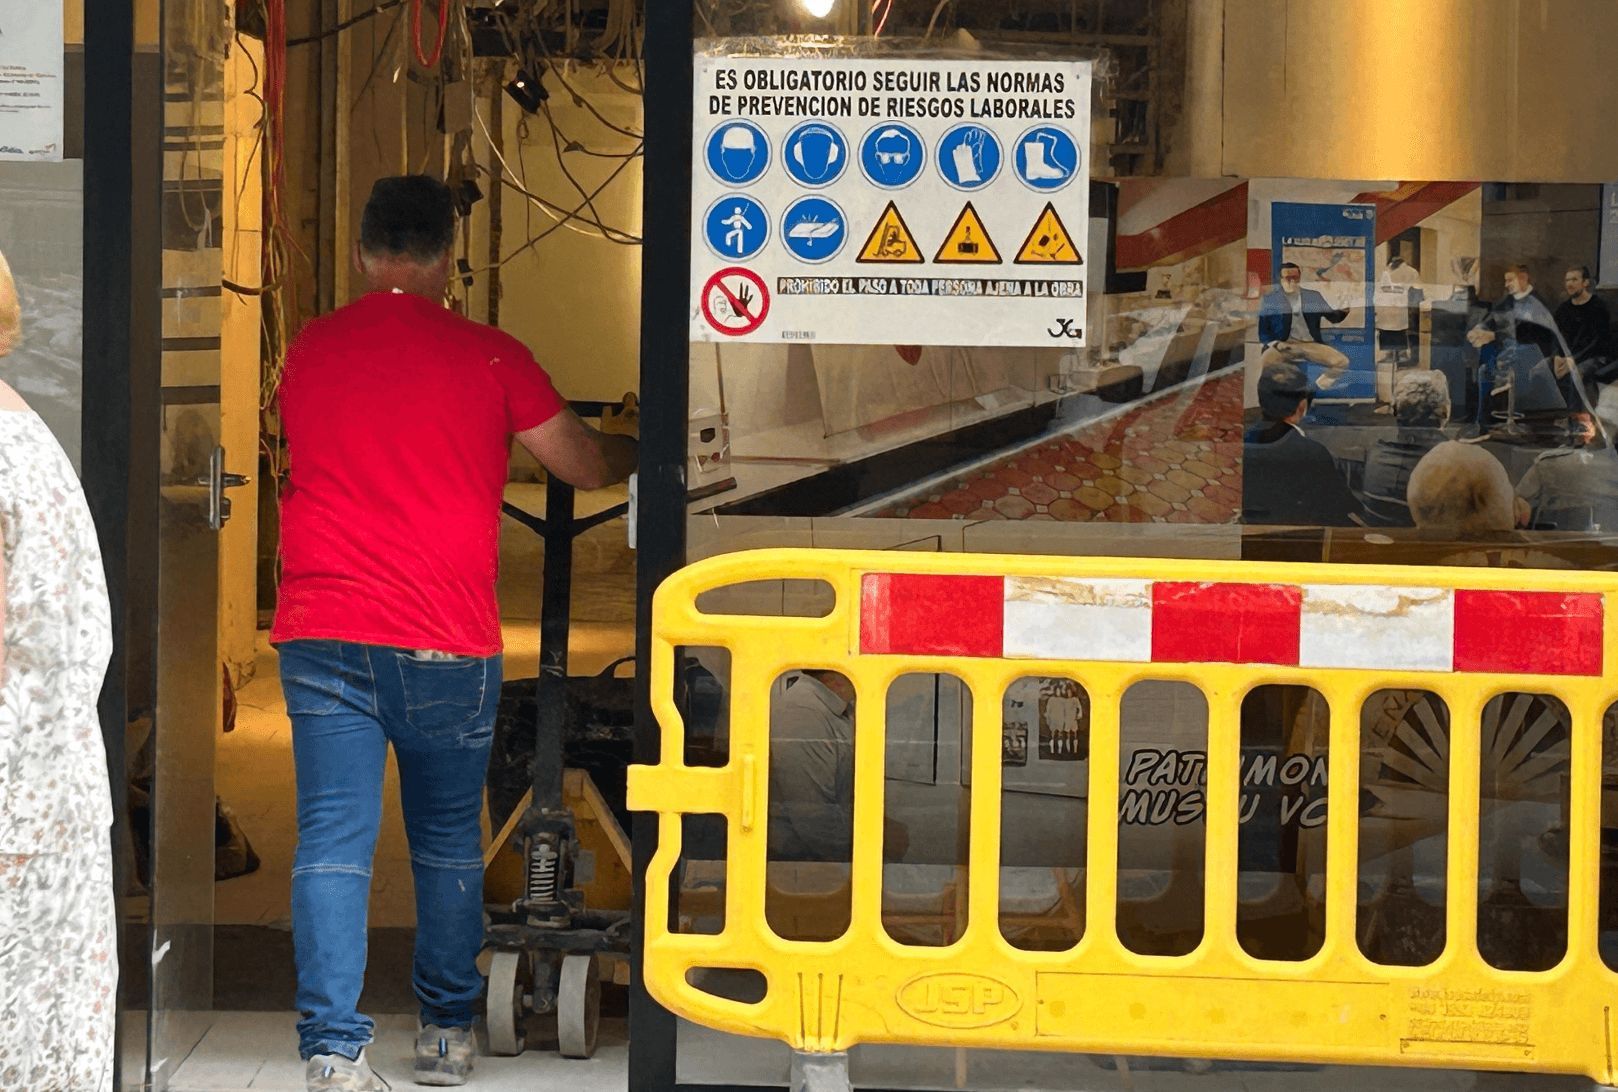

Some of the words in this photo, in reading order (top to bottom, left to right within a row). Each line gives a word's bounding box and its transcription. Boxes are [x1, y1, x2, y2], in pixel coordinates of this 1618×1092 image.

[715, 69, 738, 90] ES
[743, 69, 867, 92] OBLIGATORIO
[872, 71, 941, 92] SEGUIR
[947, 72, 981, 92] LAS
[987, 72, 1065, 93] NORMAS
[709, 95, 732, 115] DE
[738, 95, 852, 116] PREVENCION
[858, 97, 880, 117] DE
[887, 97, 965, 118] RIESGOS
[970, 98, 1076, 119] LABORALES
[842, 279, 856, 294] EL
[889, 279, 898, 294] A
[1023, 281, 1033, 297] A
[1034, 281, 1050, 297] LA
[1117, 788, 1260, 826] MUSU
